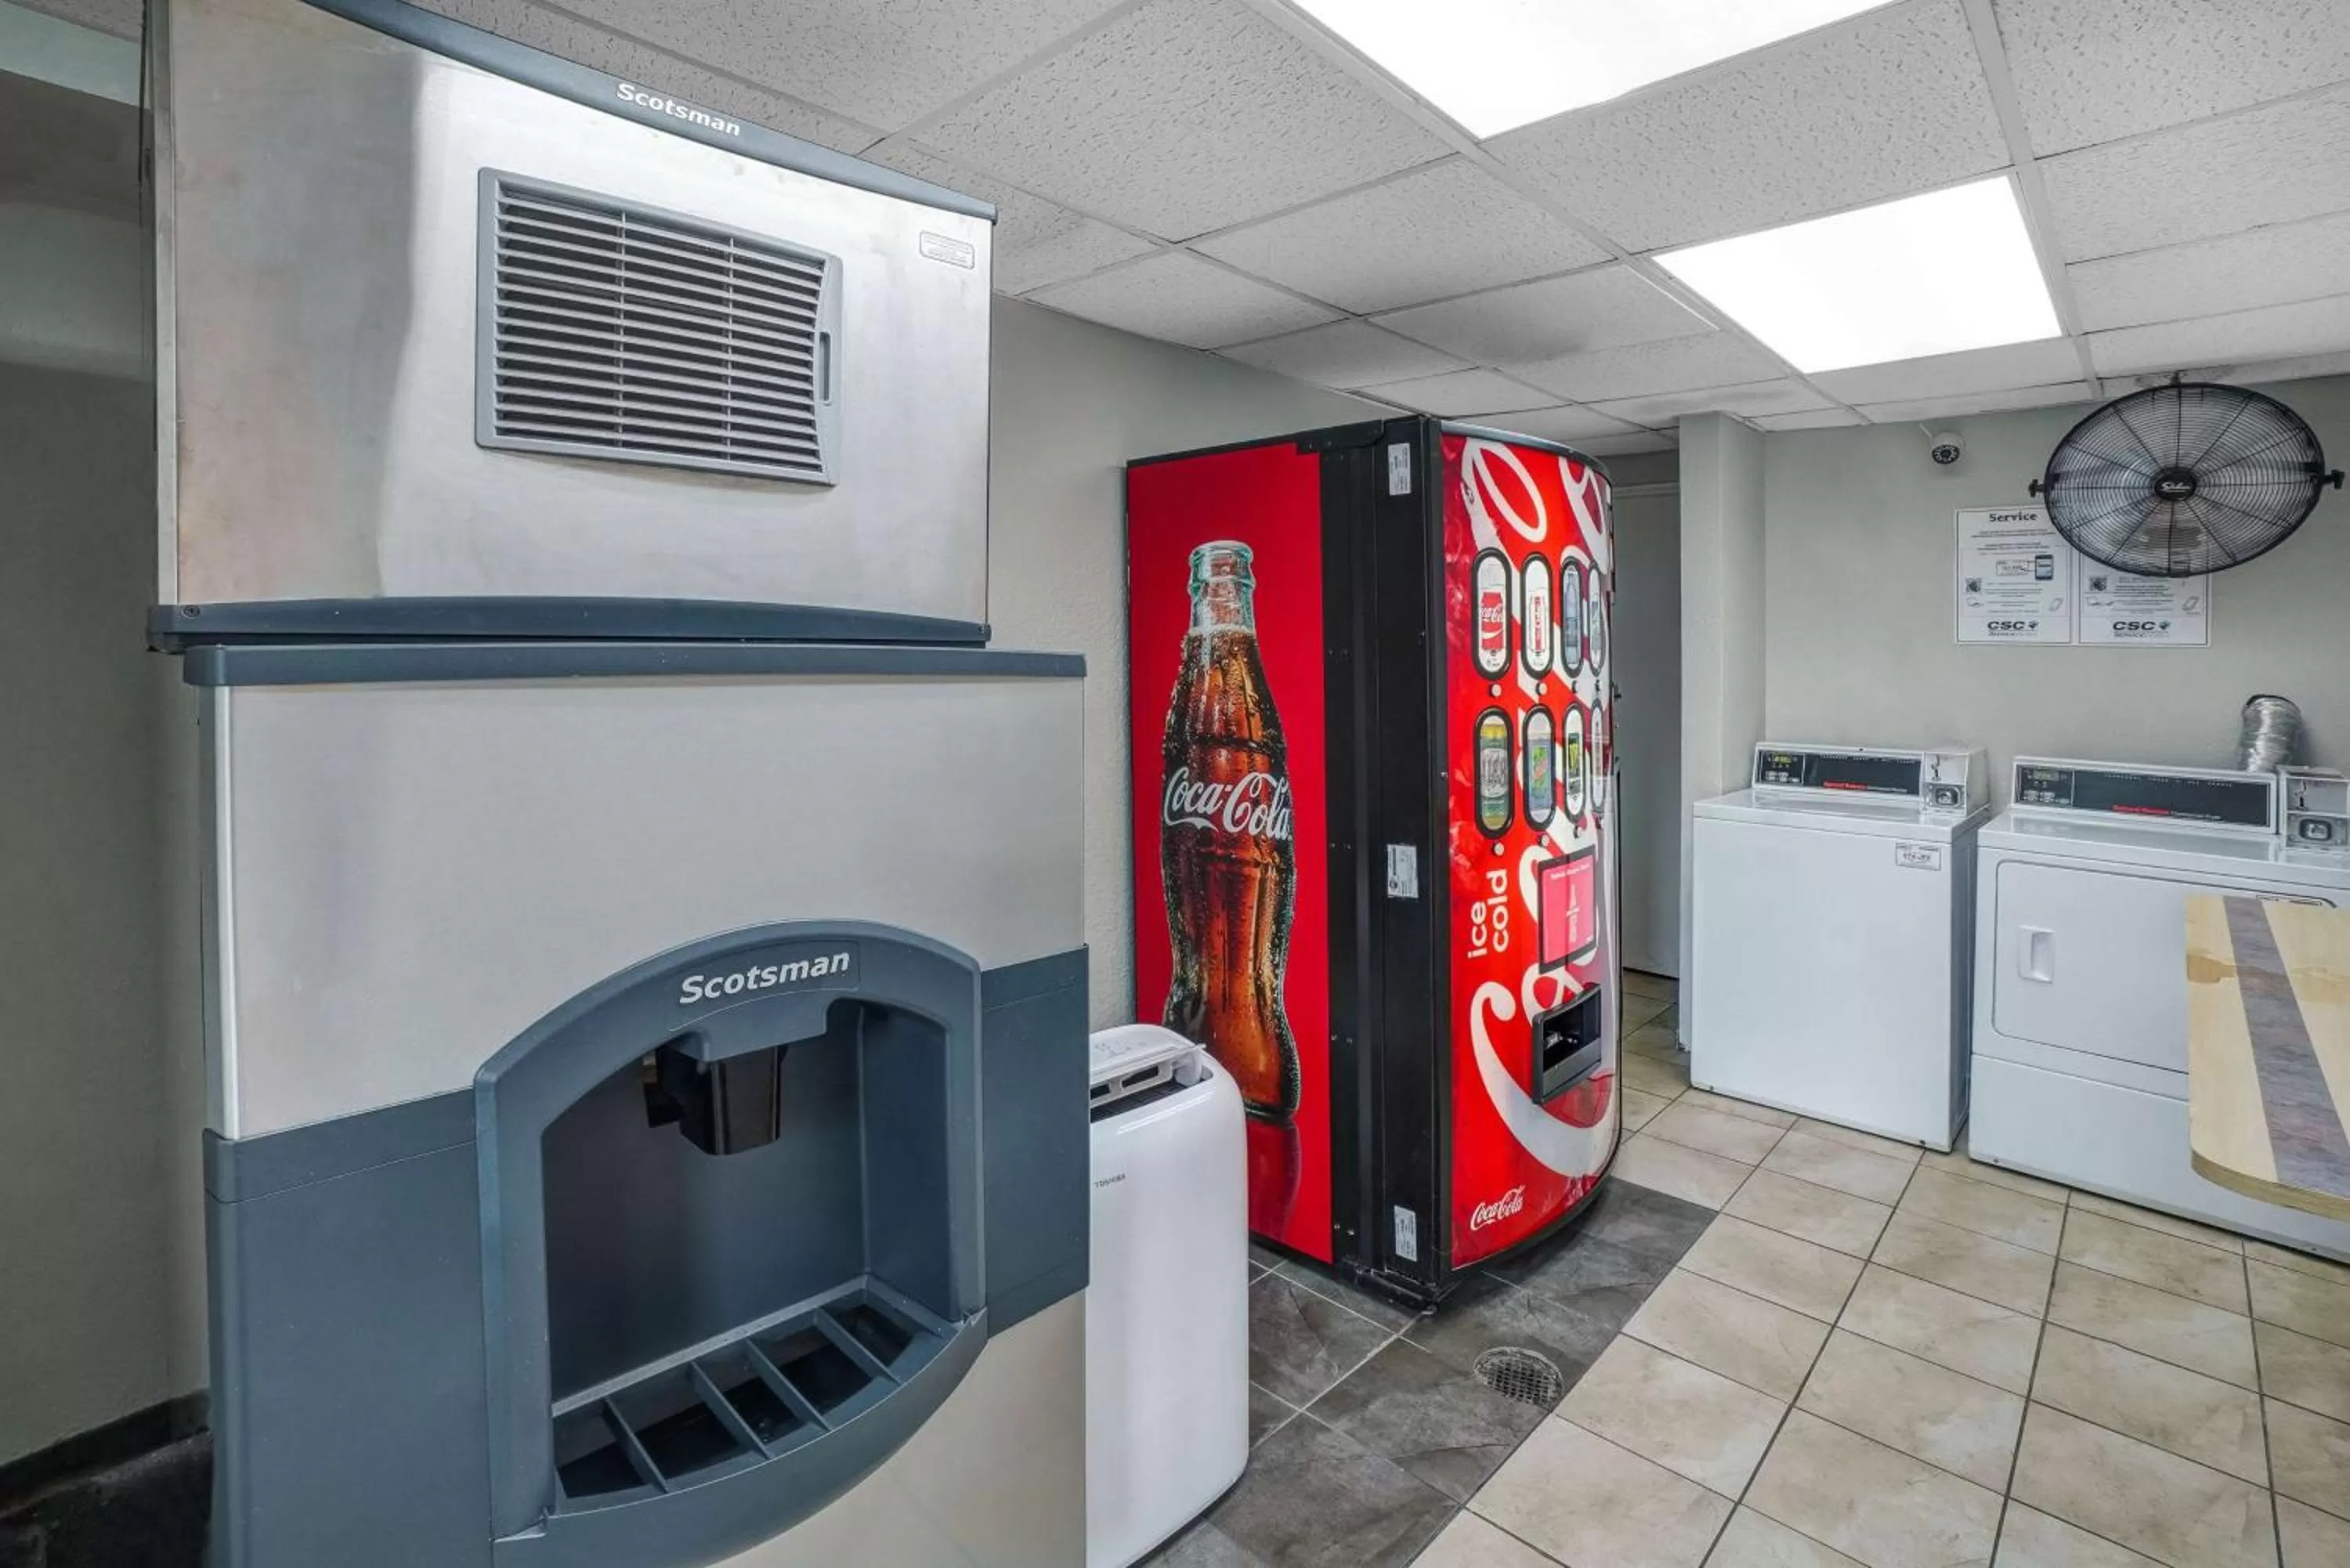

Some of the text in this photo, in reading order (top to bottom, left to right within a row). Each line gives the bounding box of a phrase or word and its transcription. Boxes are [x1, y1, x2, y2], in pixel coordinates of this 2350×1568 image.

[616, 83, 740, 135] Scotsman
[1989, 511, 2037, 522] Service
[1987, 621, 2026, 630] CSC
[2113, 621, 2156, 630] CSC
[1164, 767, 1291, 840] Coca-Cola
[1467, 901, 1488, 959] ice
[1486, 869, 1509, 952] cold
[679, 952, 850, 1004] Scotsman
